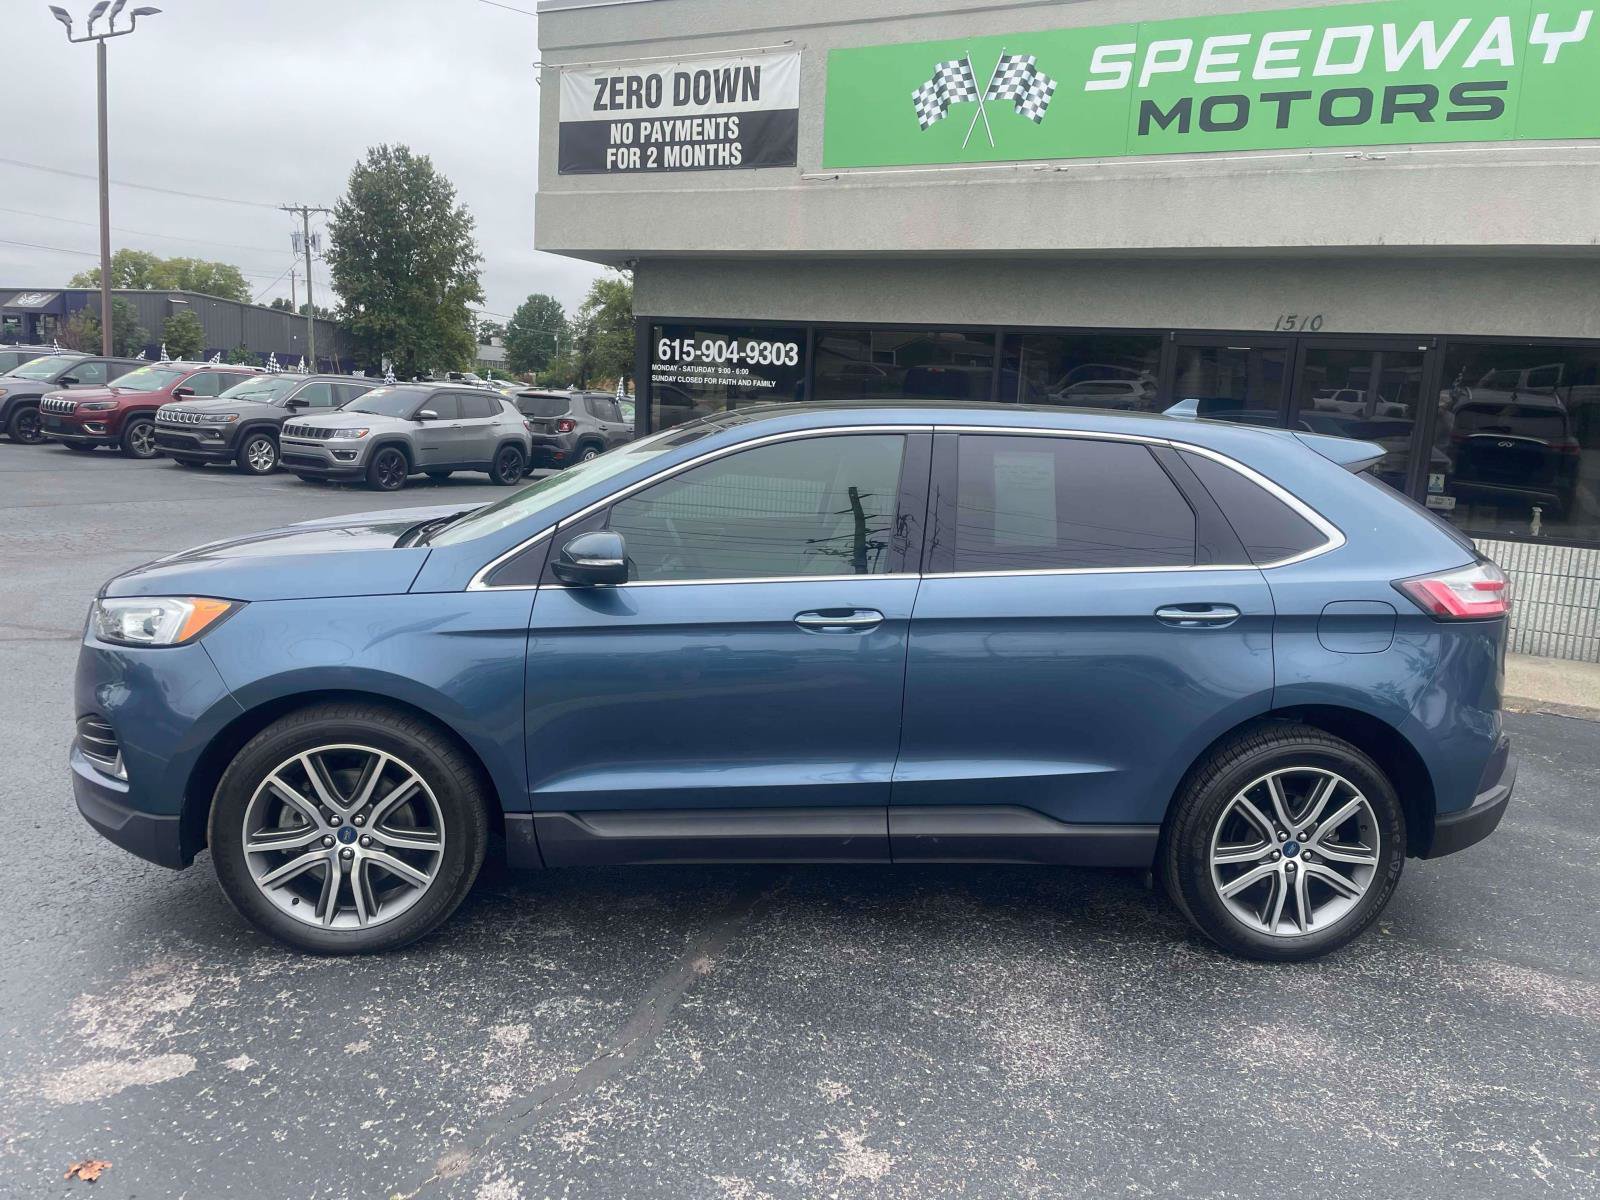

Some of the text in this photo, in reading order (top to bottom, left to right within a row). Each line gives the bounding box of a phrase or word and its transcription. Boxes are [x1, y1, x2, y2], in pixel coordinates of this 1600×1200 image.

[1084, 10, 1594, 92] SPEEDWAY
[593, 65, 761, 111] ZERO DOWN
[1137, 80, 1509, 136] MOTORS
[610, 116, 739, 145] NO PAYMENTS
[606, 142, 742, 169] FOR 2 MONTHS
[1274, 314, 1323, 331] 1510
[658, 338, 798, 366] 615-904-9303
[651, 364, 678, 372] MONDAY
[682, 365, 715, 373] SATURDAY
[651, 374, 676, 382] SUNDAY
[677, 376, 703, 384] CLOSED
[718, 378, 736, 386] FAITH
[752, 379, 776, 388] FAMILY
